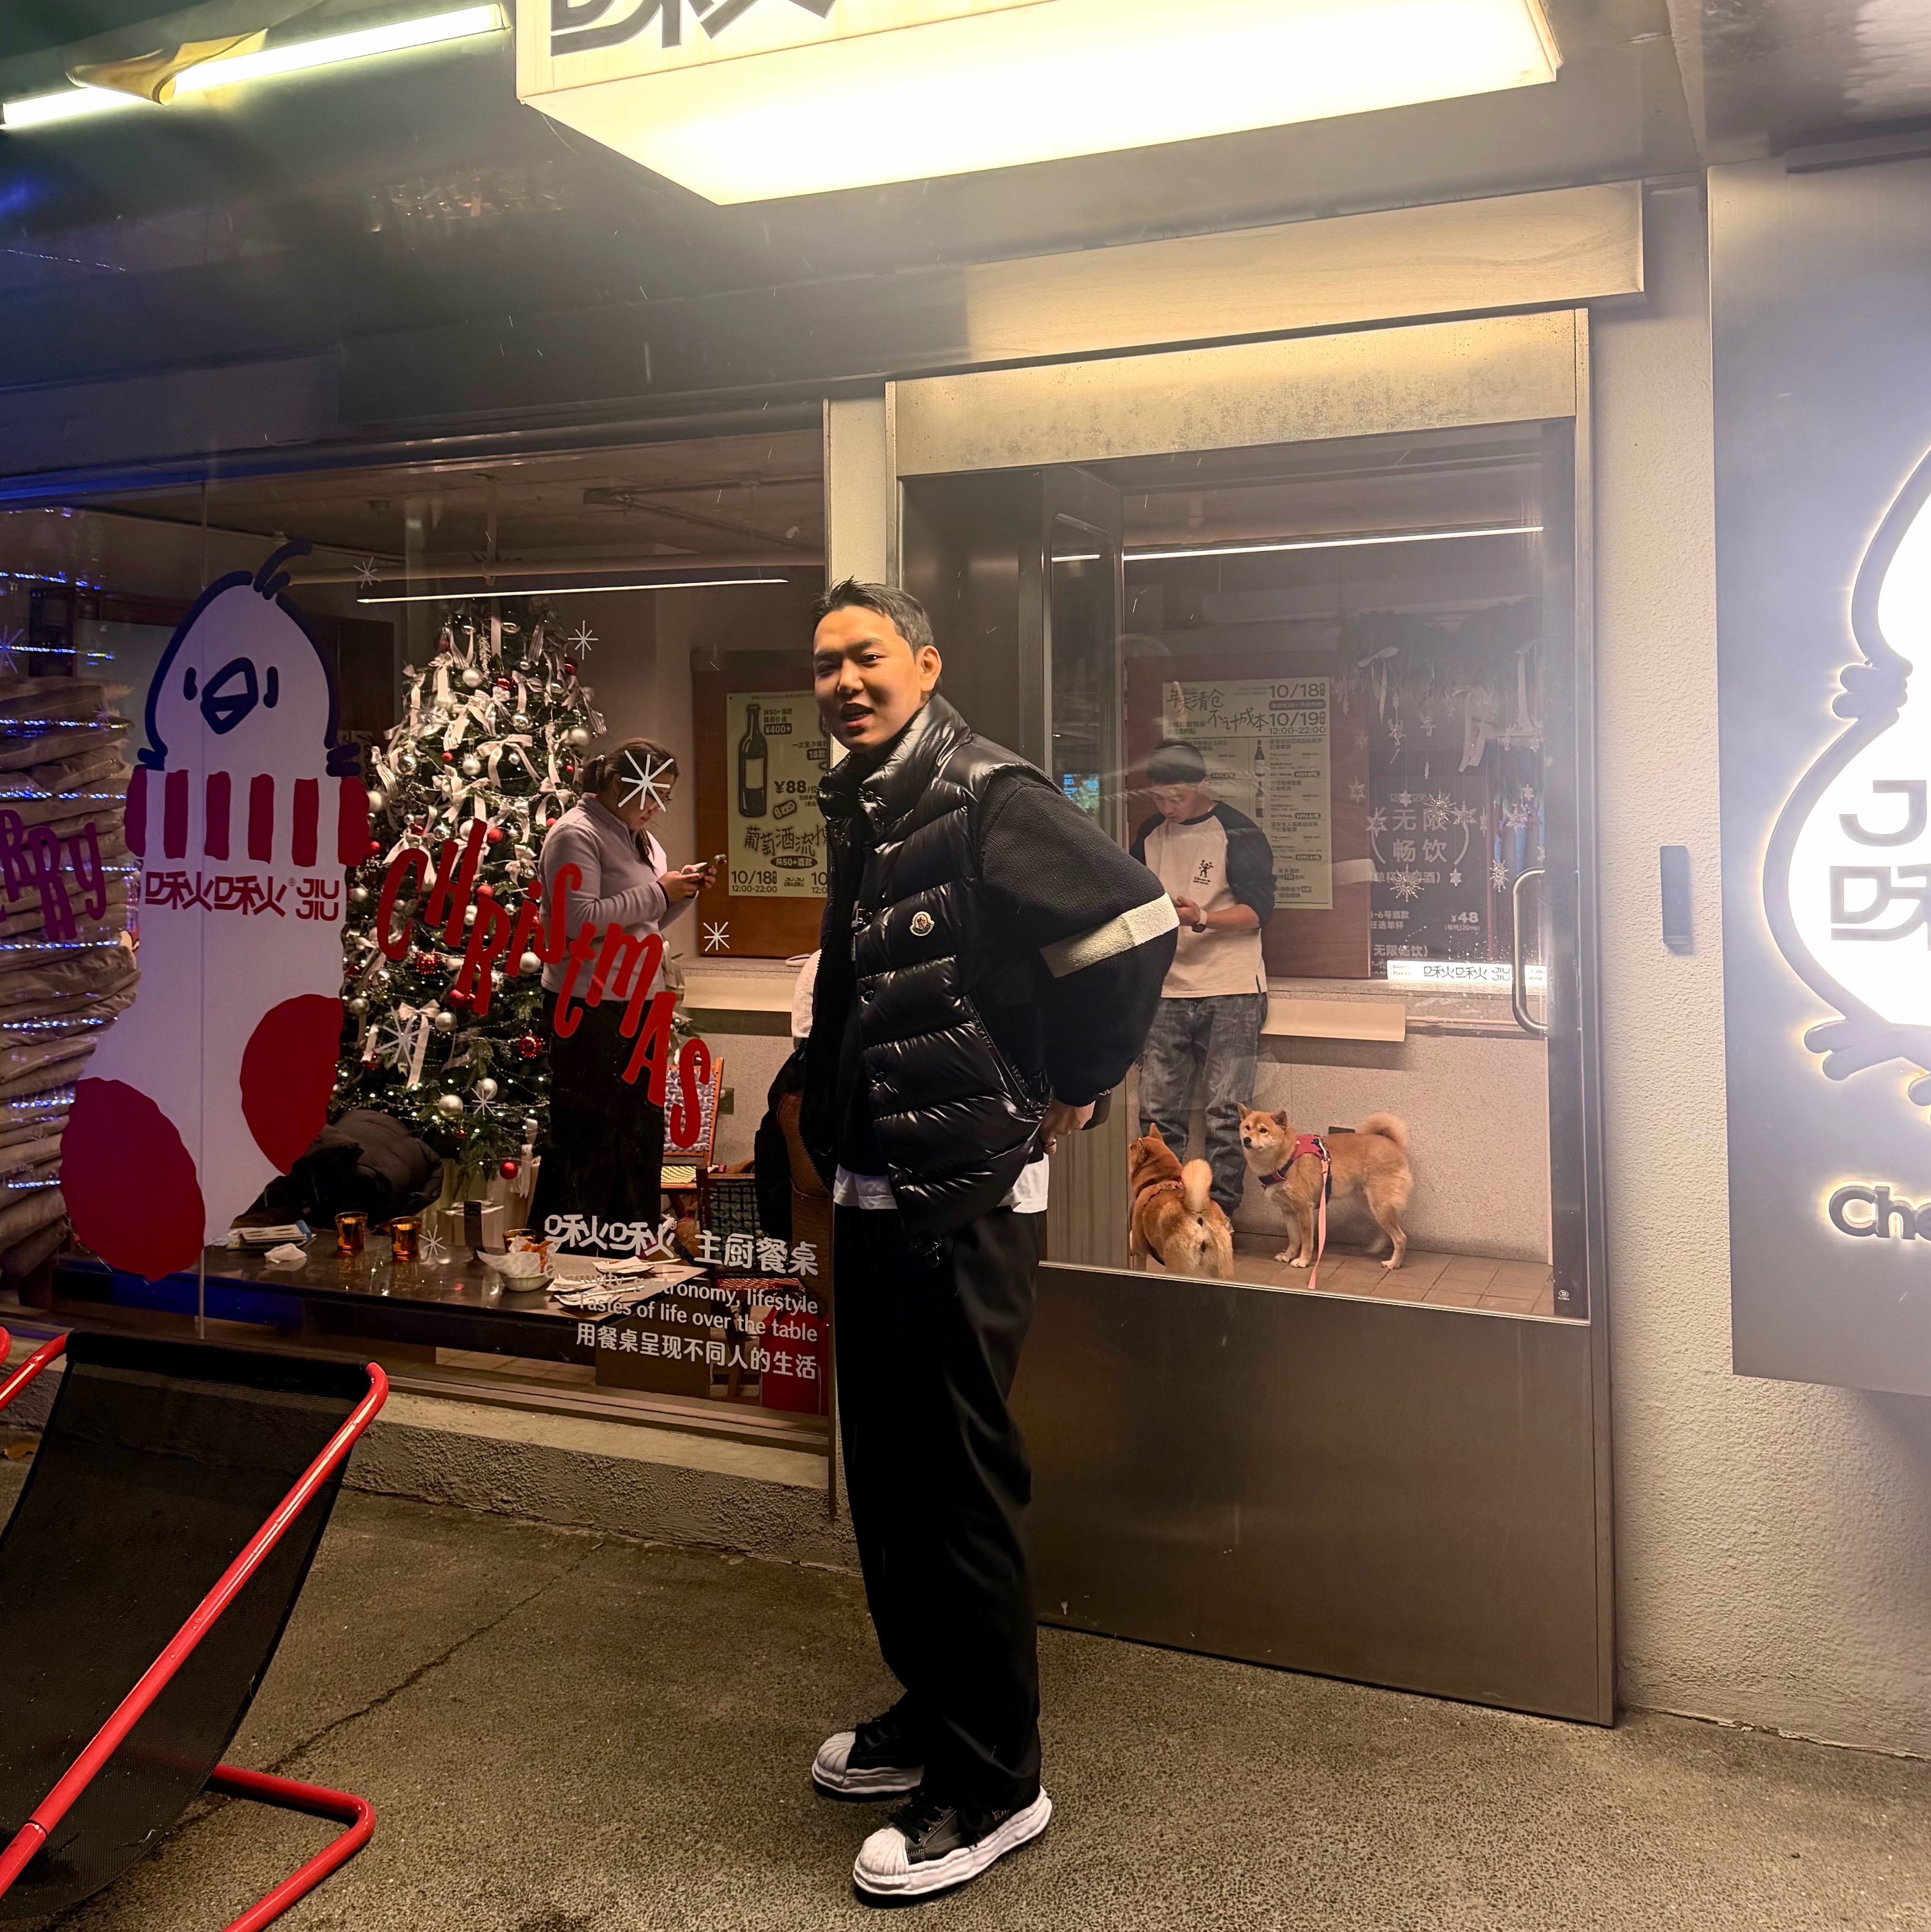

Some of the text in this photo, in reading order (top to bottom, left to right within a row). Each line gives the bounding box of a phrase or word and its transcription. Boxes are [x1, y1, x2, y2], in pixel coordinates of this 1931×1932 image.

[1269, 683, 1319, 698] 10/18
[1269, 711, 1319, 727] 10/19
[765, 725, 791, 734] ¥400+
[1269, 726, 1326, 735] 12:00-22:00
[1392, 839, 1448, 863] 畅饮
[731, 870, 772, 884] 10/18
[296, 879, 339, 899] JIU
[296, 900, 338, 921] JIU
[1451, 911, 1479, 923] ¥48
[1828, 1185, 1931, 1242] Ch
[694, 1230, 818, 1276] 主厨餐桌
[747, 1289, 818, 1316] lifestyle
[579, 1292, 818, 1342] Tastes of life over the table
[576, 1322, 817, 1379] 用餐桌呈现不同人的生活
